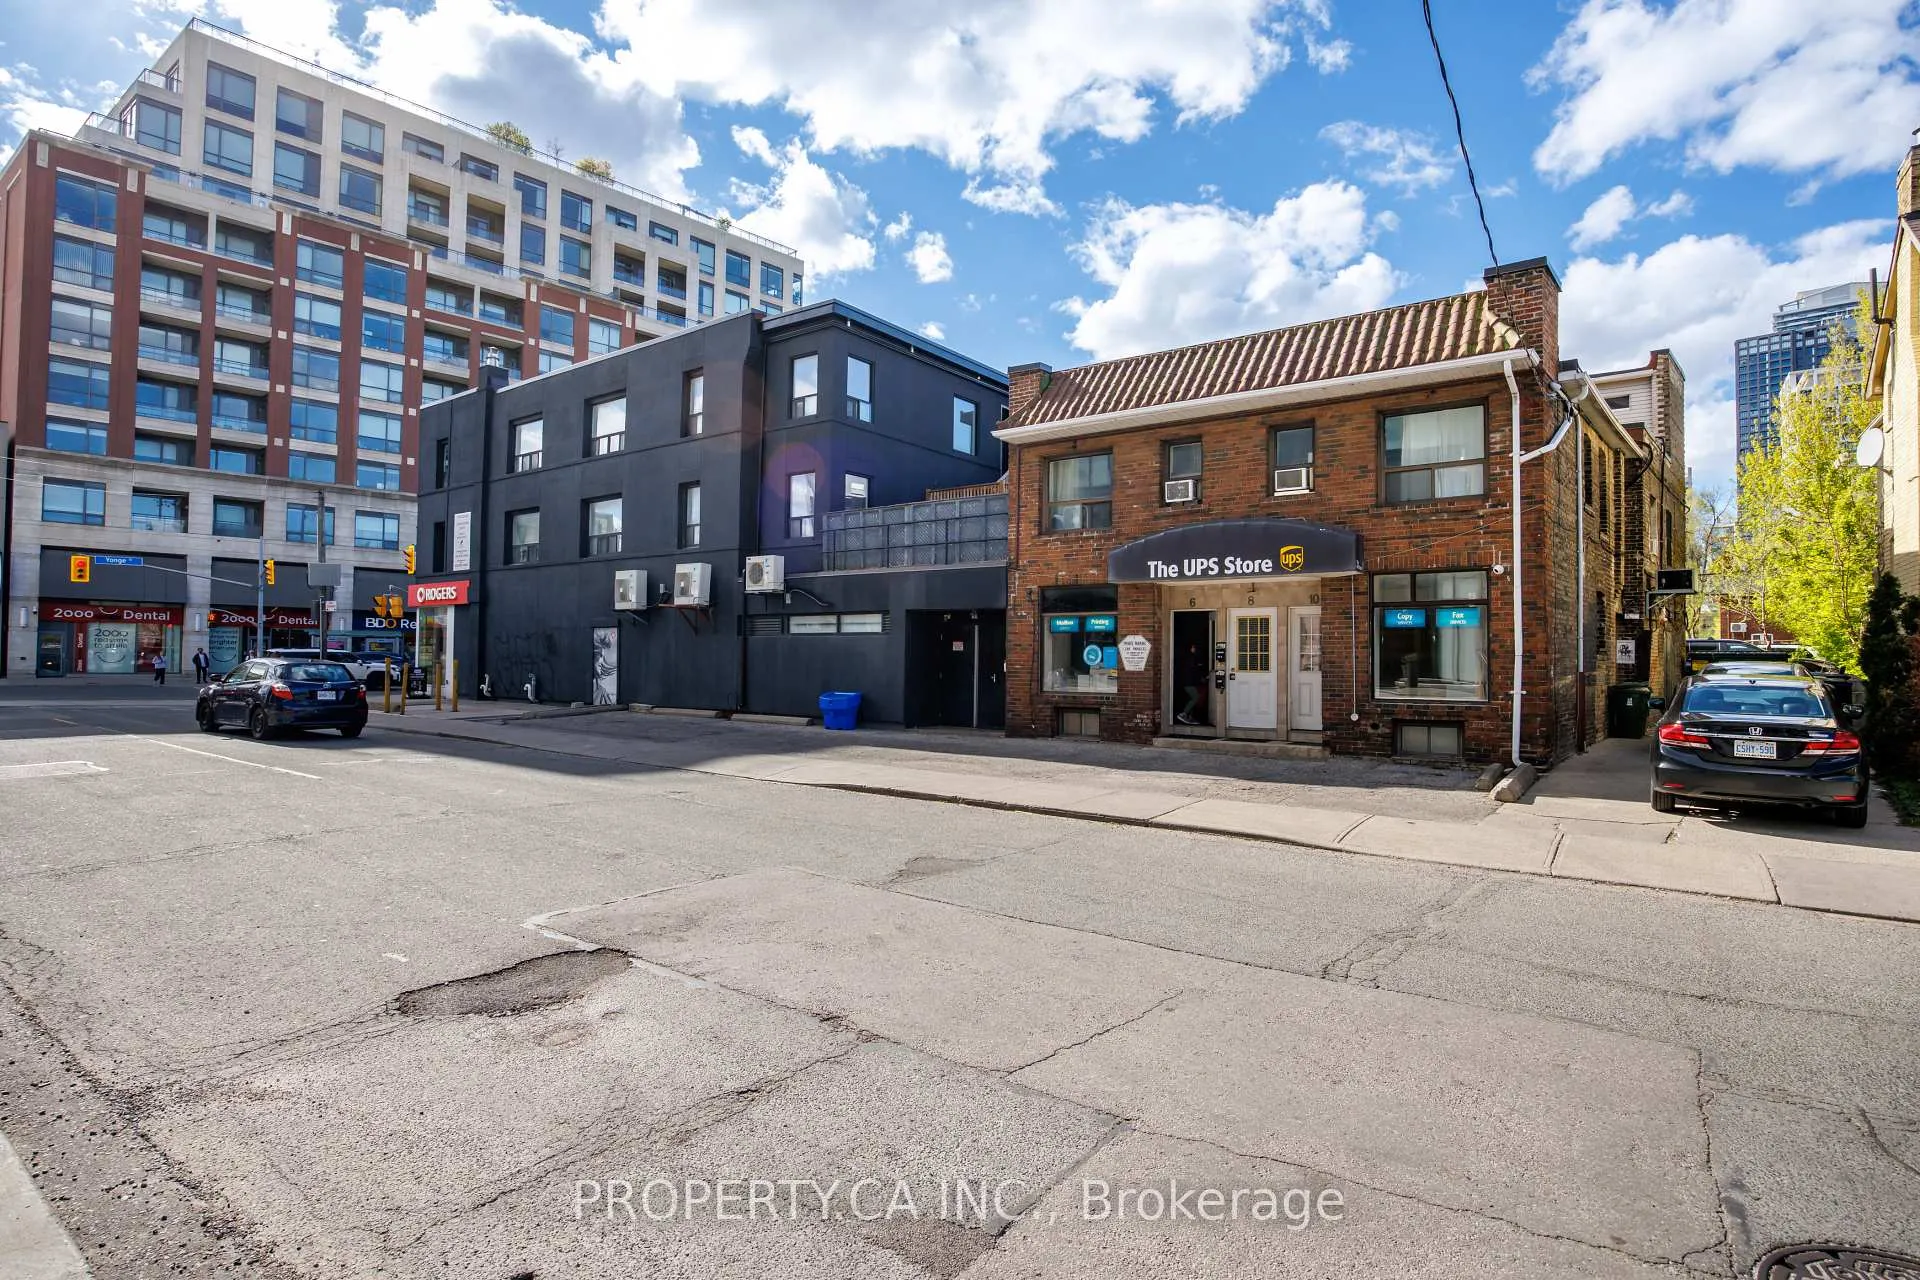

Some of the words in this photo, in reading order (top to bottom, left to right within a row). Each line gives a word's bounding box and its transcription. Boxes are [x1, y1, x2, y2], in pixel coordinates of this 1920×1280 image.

[1282, 552, 1302, 567] ups
[1147, 561, 1178, 578] The
[1183, 557, 1219, 576] UPS
[1224, 556, 1272, 574] Store
[425, 586, 457, 600] ROGERS
[1189, 597, 1196, 607] 6
[1247, 596, 1255, 605] 8
[1309, 594, 1320, 604] 10
[53, 608, 94, 618] 2000
[123, 609, 170, 621] Dental
[221, 614, 255, 623] 2000
[1397, 612, 1413, 621] Copy
[1452, 611, 1464, 619] Fax
[365, 617, 397, 629] BDO
